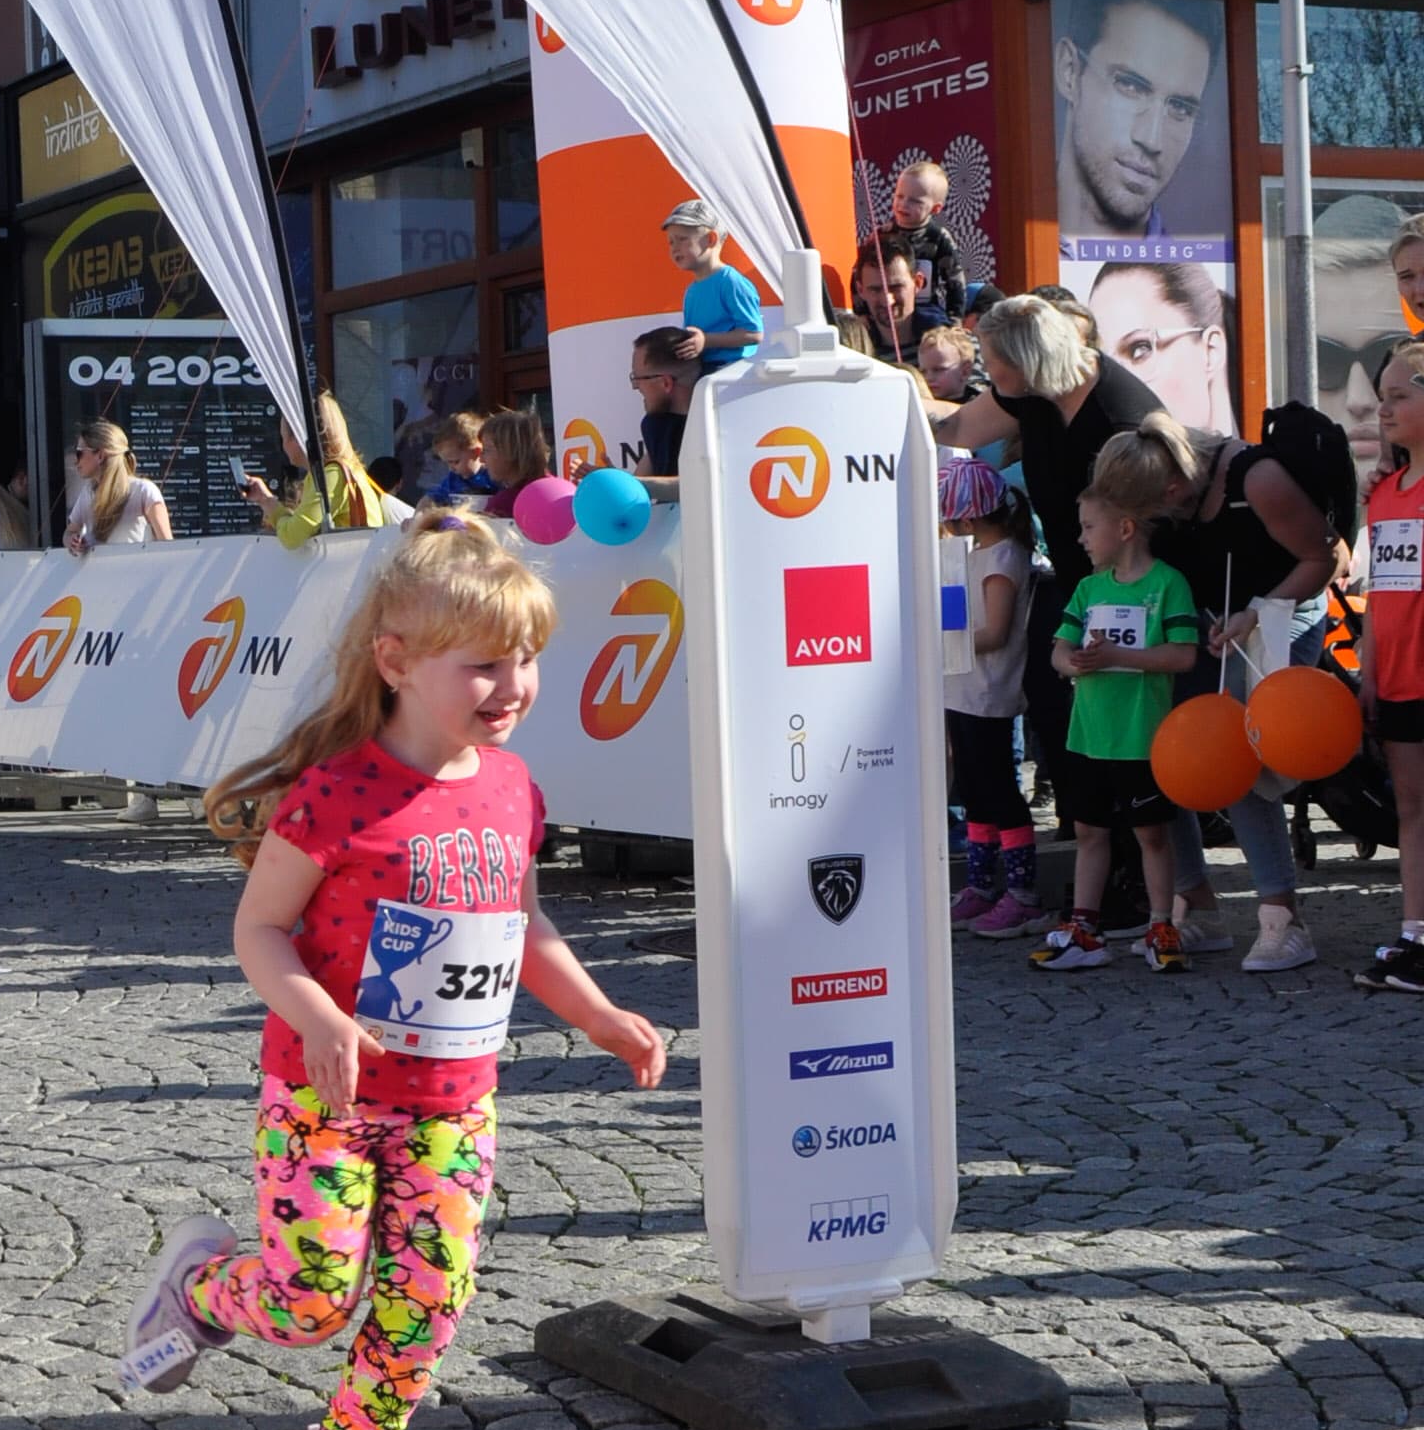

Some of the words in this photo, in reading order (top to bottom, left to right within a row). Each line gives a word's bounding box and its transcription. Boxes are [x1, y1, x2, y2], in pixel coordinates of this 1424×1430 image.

[875, 38, 941, 66] OPTIKA
[1081, 244, 1193, 259] LINDBERG
[68, 355, 135, 386] 04
[846, 454, 895, 483] NN
[1376, 544, 1418, 563] 3042
[74, 631, 123, 667] NN
[239, 636, 292, 675] NN
[795, 636, 862, 658] AVON
[857, 746, 894, 758] Powered
[857, 761, 868, 771] by
[872, 758, 894, 768] MVM
[769, 792, 828, 811] innogy
[408, 827, 521, 905] BERRY
[384, 921, 422, 939] KIDS
[381, 937, 415, 953] CUP
[435, 959, 516, 1000] 3214
[797, 976, 883, 998] NUTREND
[826, 1123, 897, 1151] ŠKODA
[808, 1211, 887, 1242] KPMG
